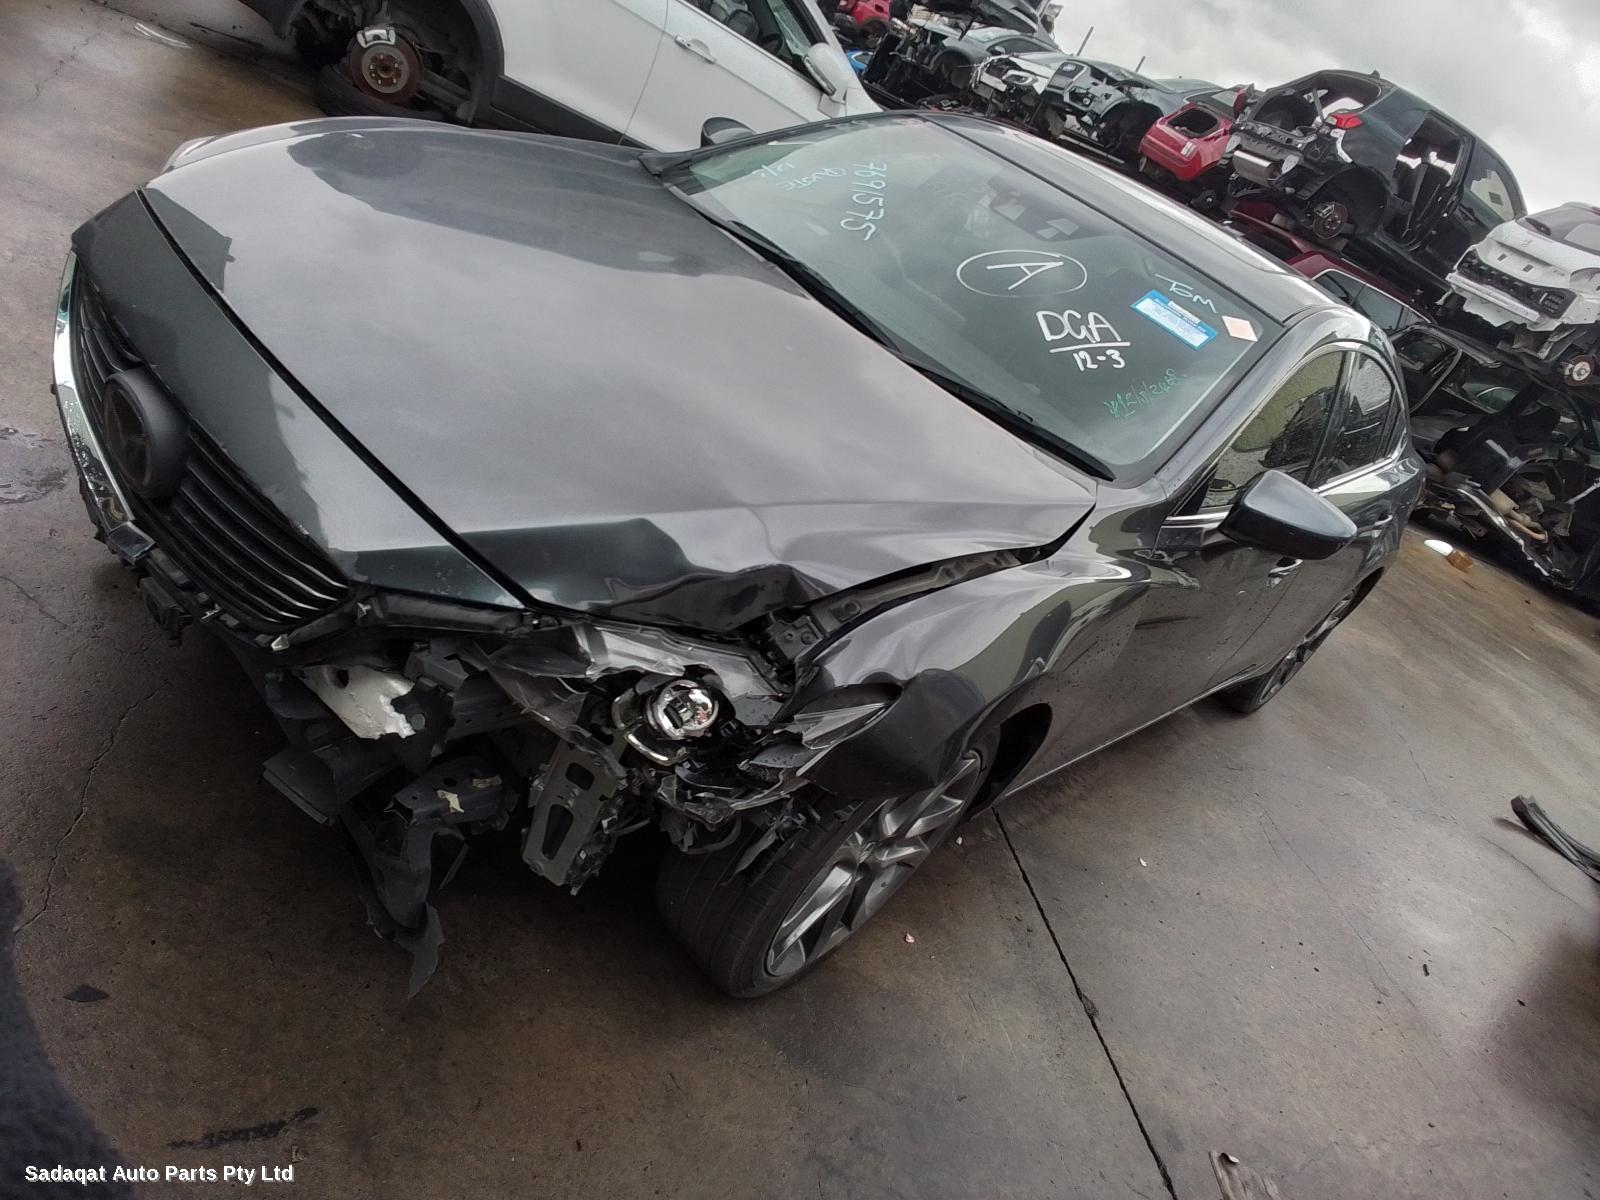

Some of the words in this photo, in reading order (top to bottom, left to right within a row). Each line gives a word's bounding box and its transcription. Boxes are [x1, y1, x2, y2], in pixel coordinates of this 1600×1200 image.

[986, 261, 1065, 291] A
[1036, 310, 1121, 343] DGA
[1072, 349, 1126, 372] 12-3
